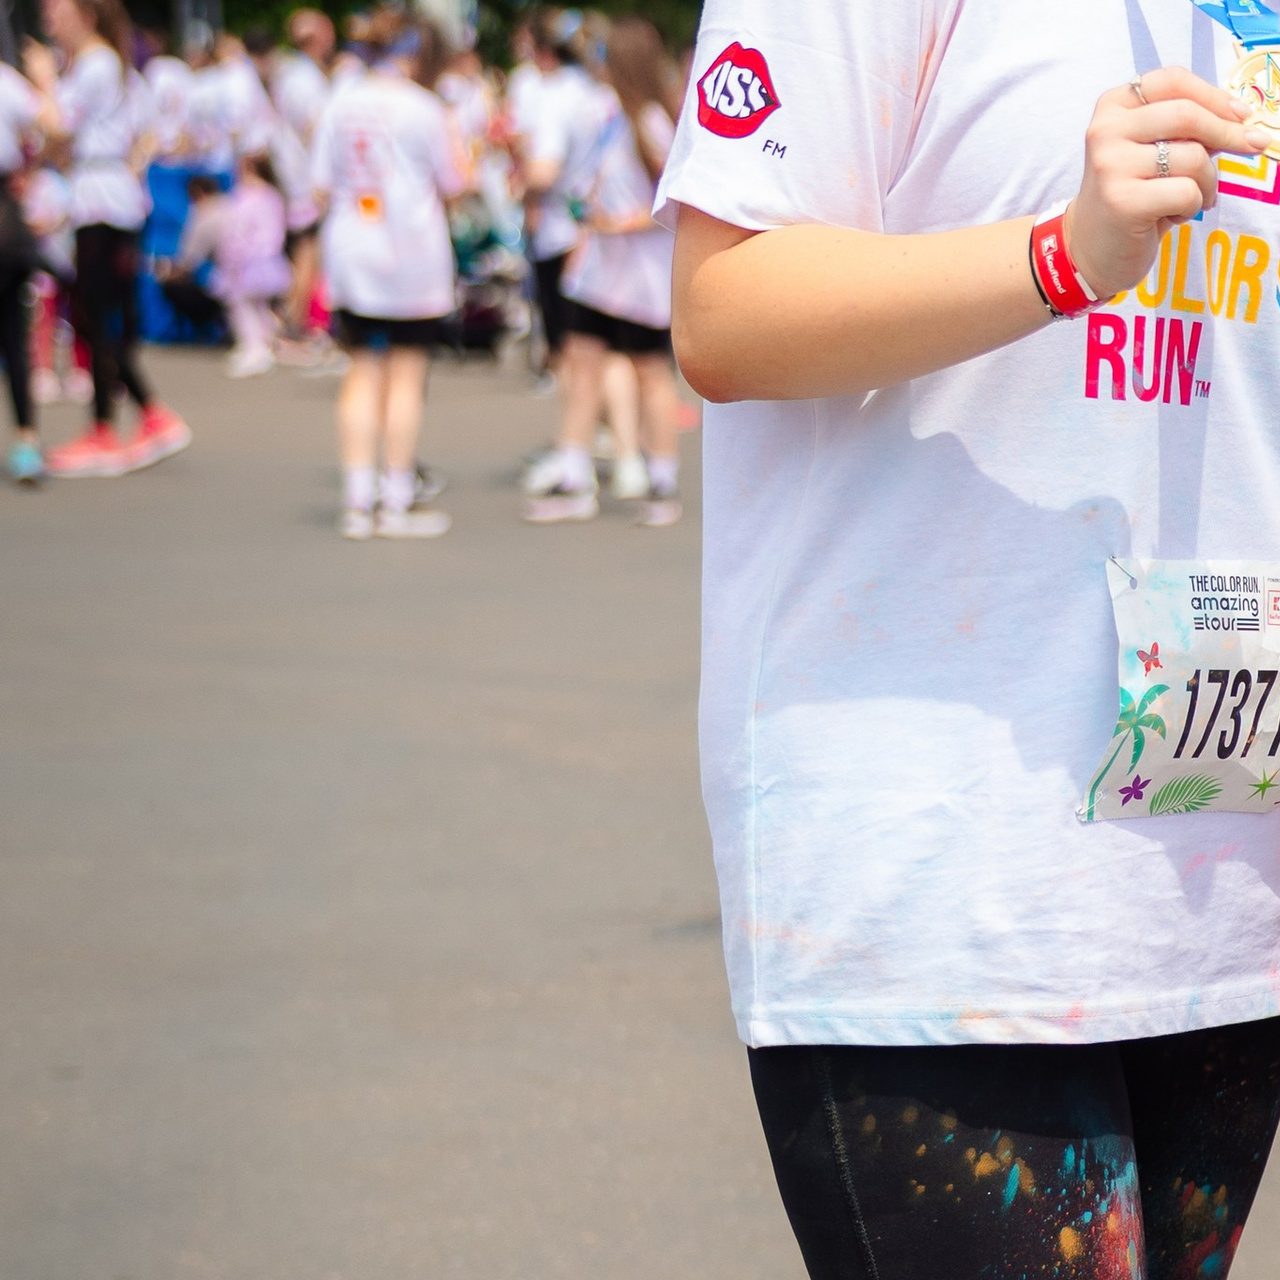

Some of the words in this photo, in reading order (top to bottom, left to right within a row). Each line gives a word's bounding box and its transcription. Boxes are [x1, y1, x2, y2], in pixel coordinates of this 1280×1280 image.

[762, 139, 787, 159] FM
[1045, 254, 1067, 295] Kaufland
[1105, 223, 1271, 325] OLOR
[1189, 575, 1209, 592] THE
[1211, 575, 1241, 593] COLOR
[1191, 594, 1259, 617] amazing
[1204, 613, 1236, 631] tour
